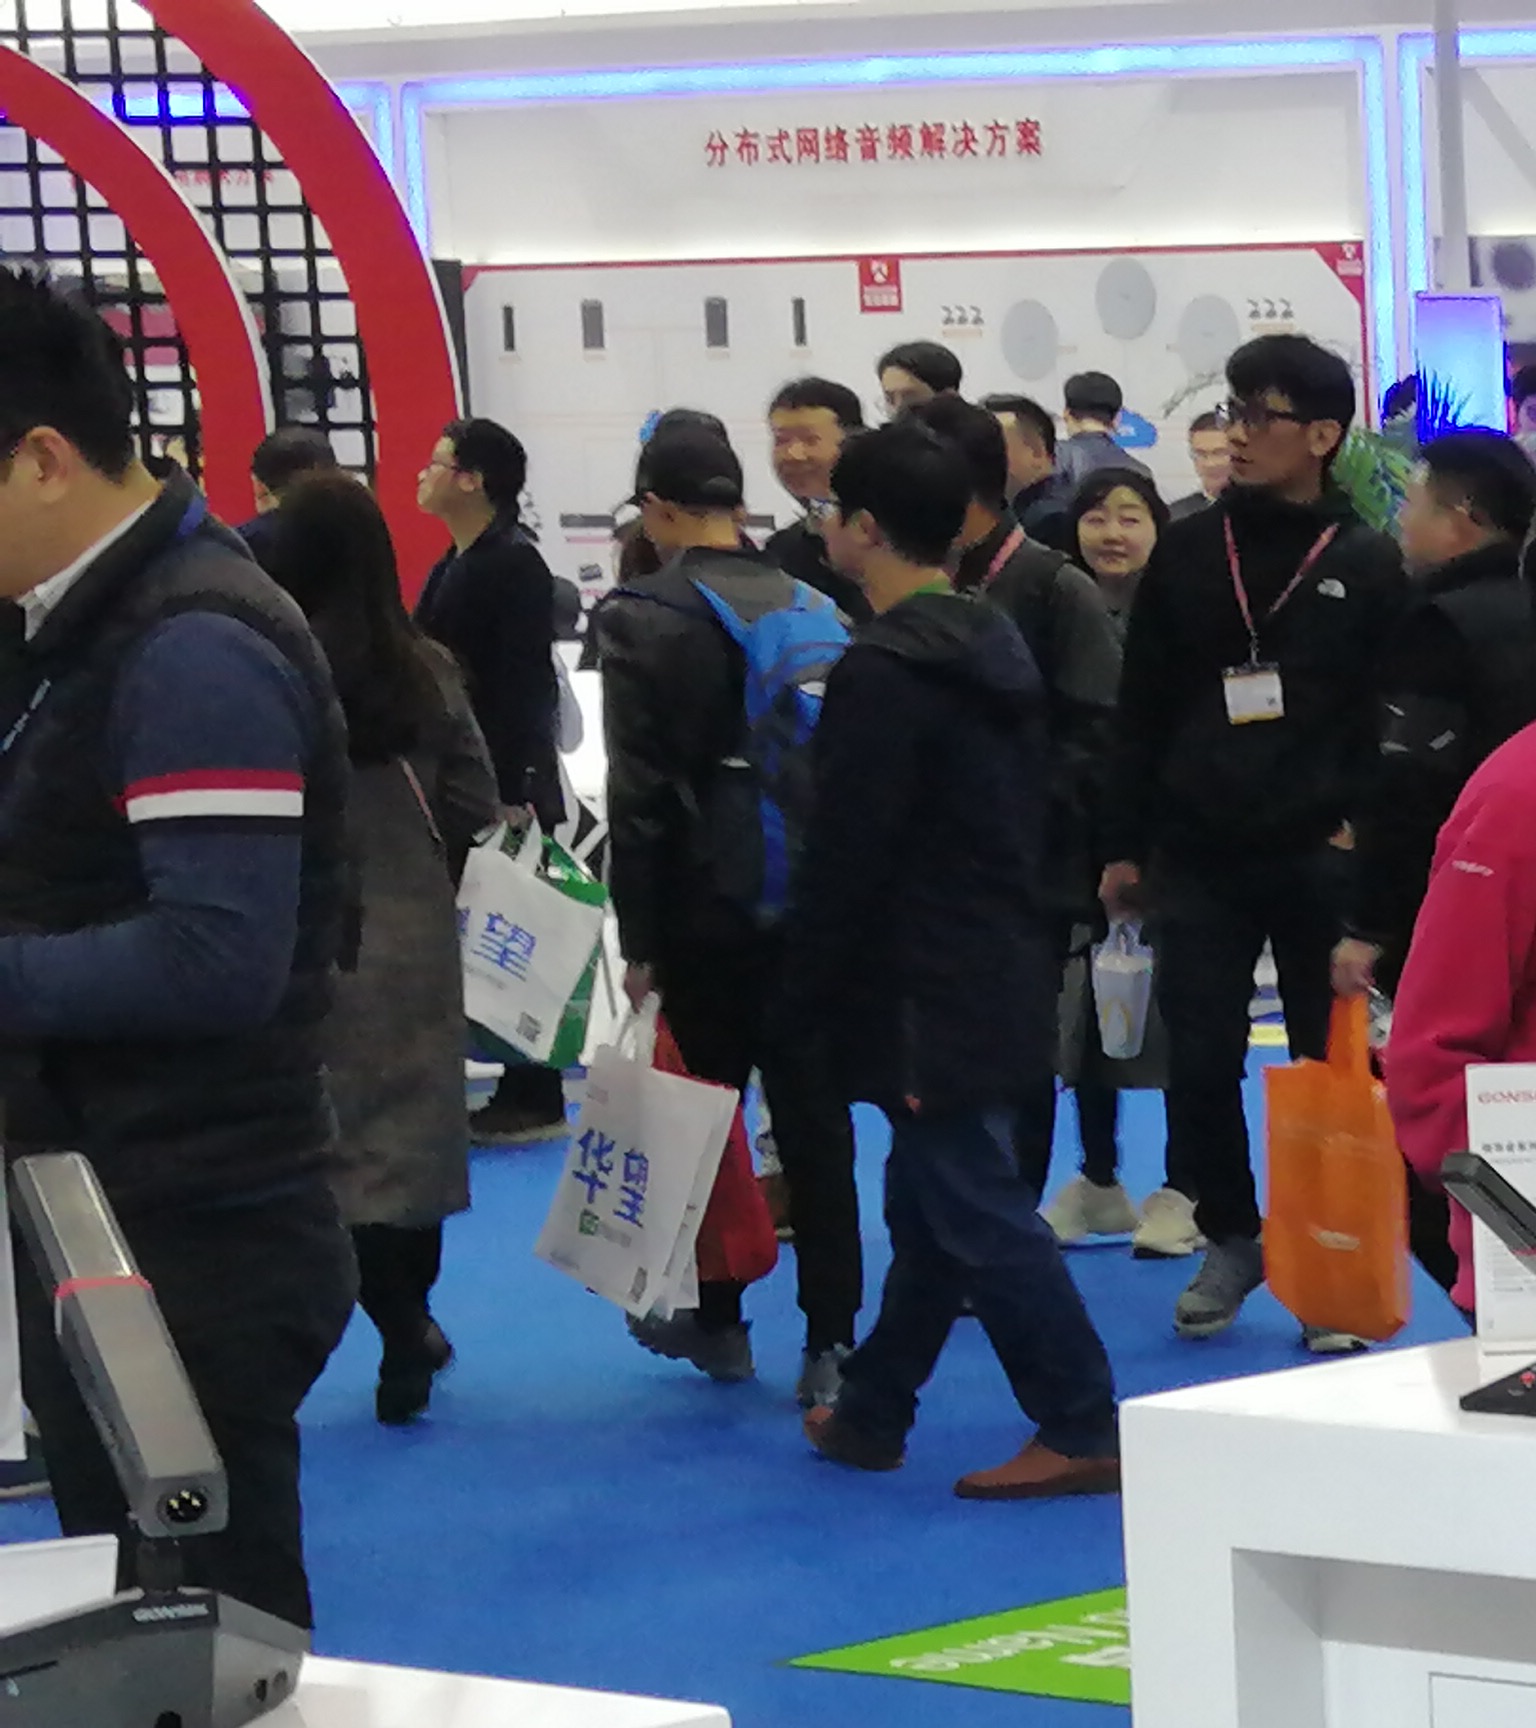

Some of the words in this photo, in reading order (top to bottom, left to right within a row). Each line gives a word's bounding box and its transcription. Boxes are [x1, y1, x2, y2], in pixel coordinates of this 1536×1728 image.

[704, 117, 1043, 167] 分布式网络音频解决方案
